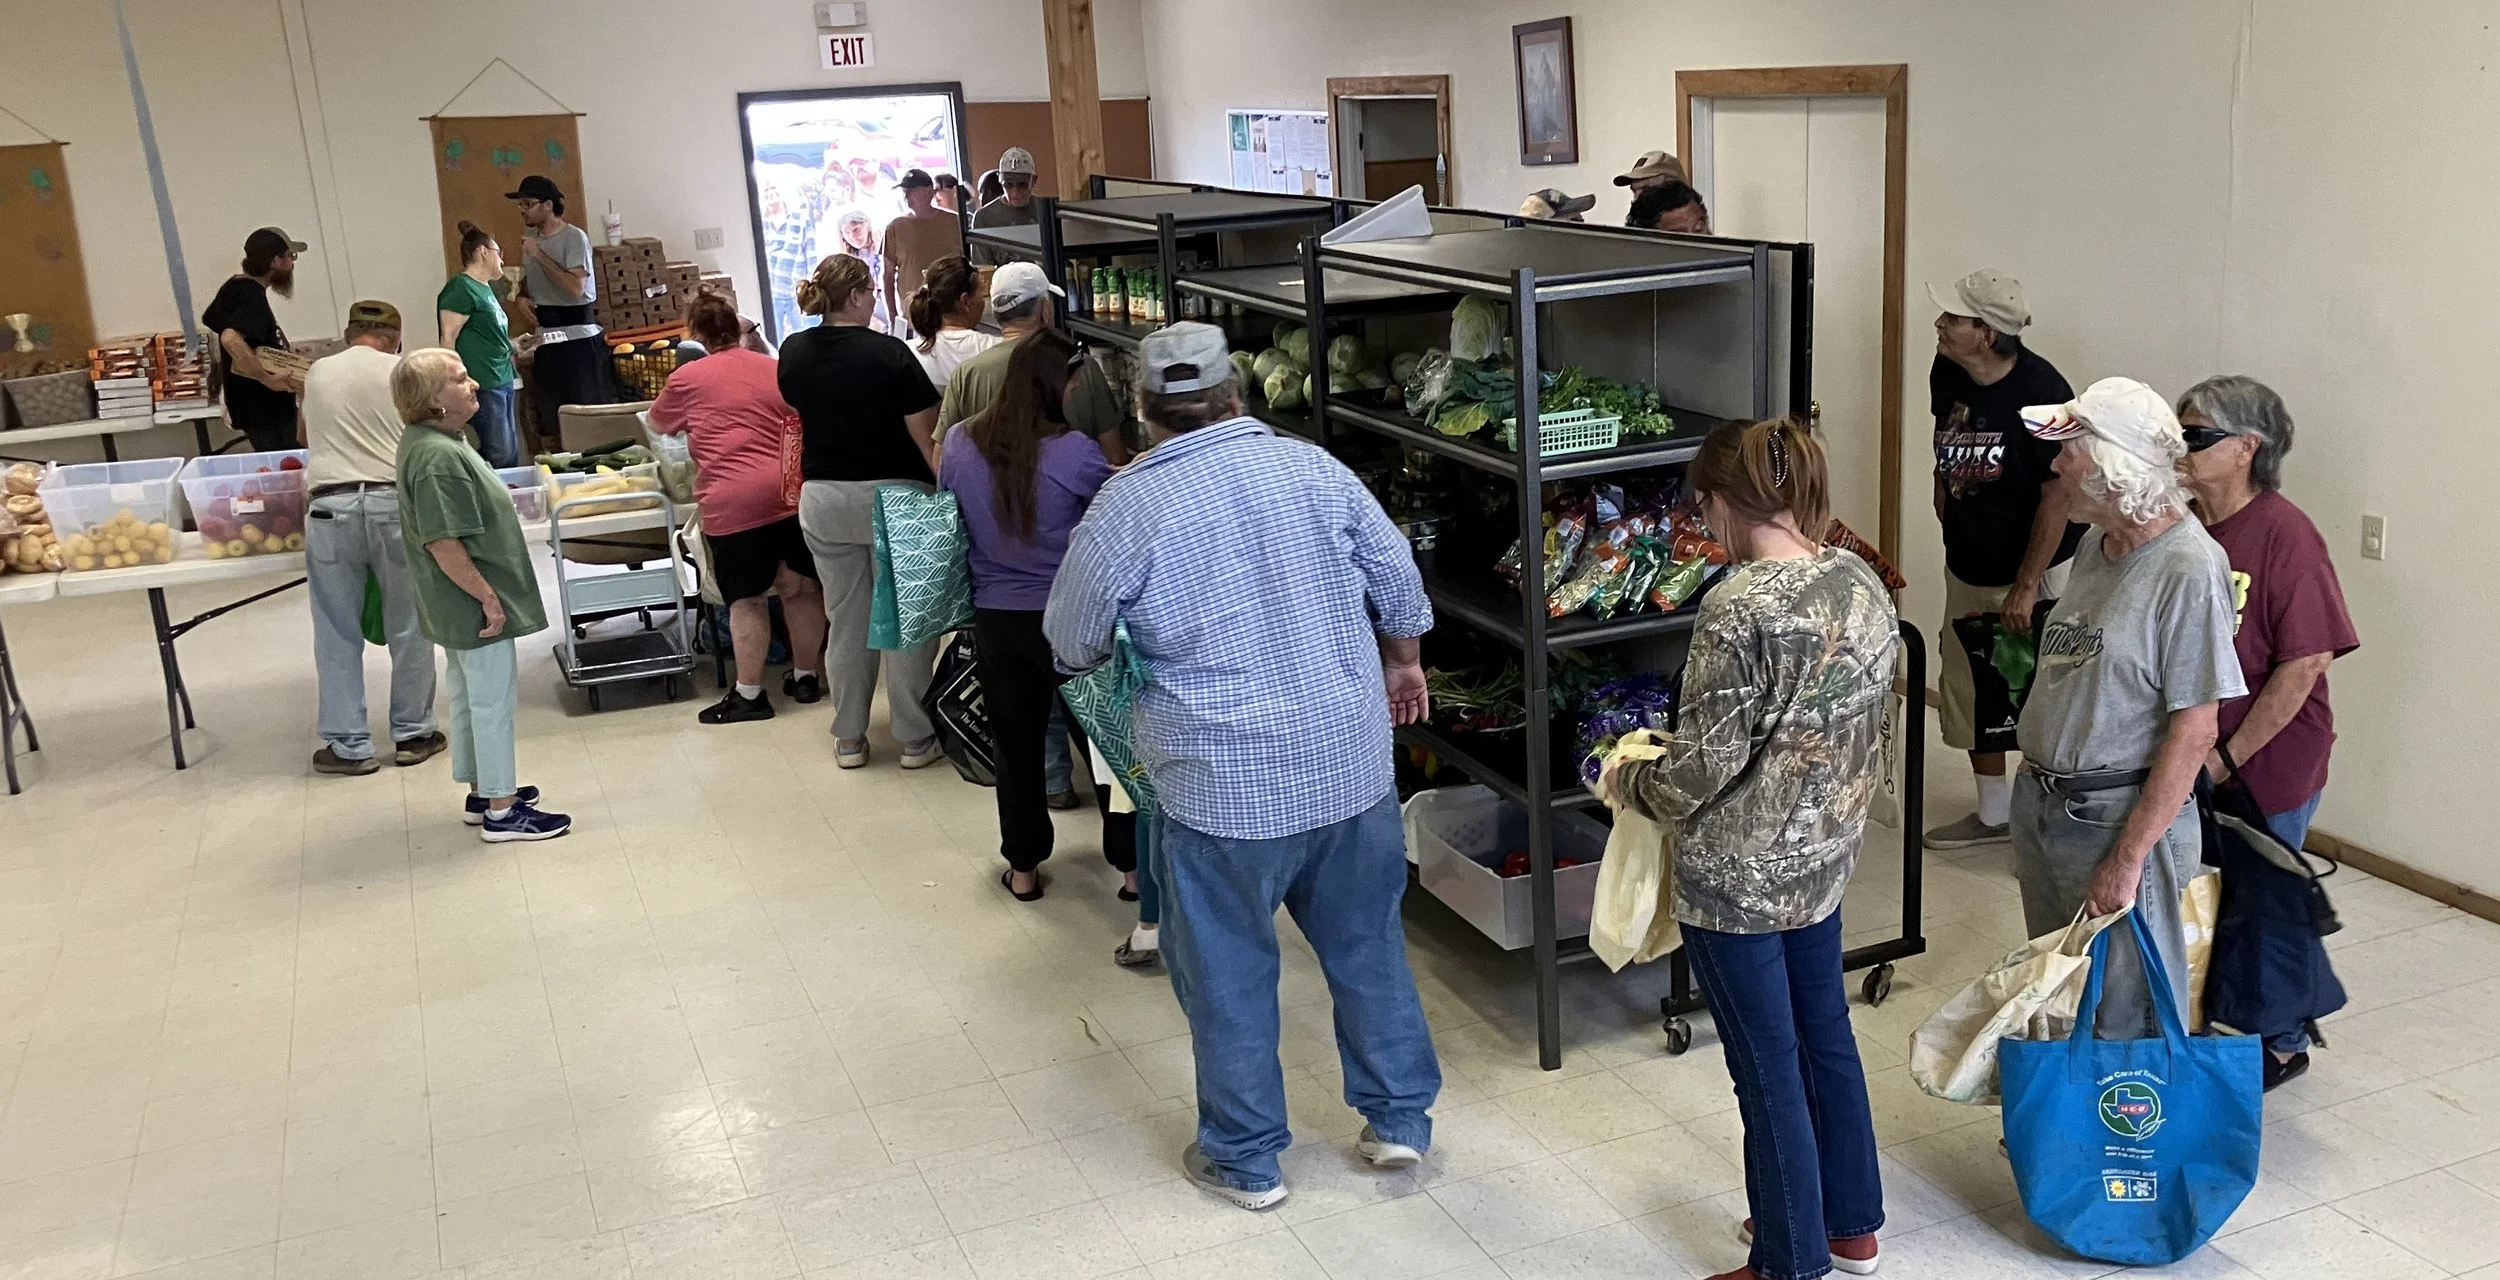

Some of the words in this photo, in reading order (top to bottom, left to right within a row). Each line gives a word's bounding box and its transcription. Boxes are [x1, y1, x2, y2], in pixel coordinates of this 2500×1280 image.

[830, 38, 864, 65] EXIT
[1009, 158, 1019, 169] T
[1976, 432, 2003, 444] WITH
[2096, 1075, 2114, 1086] Take
